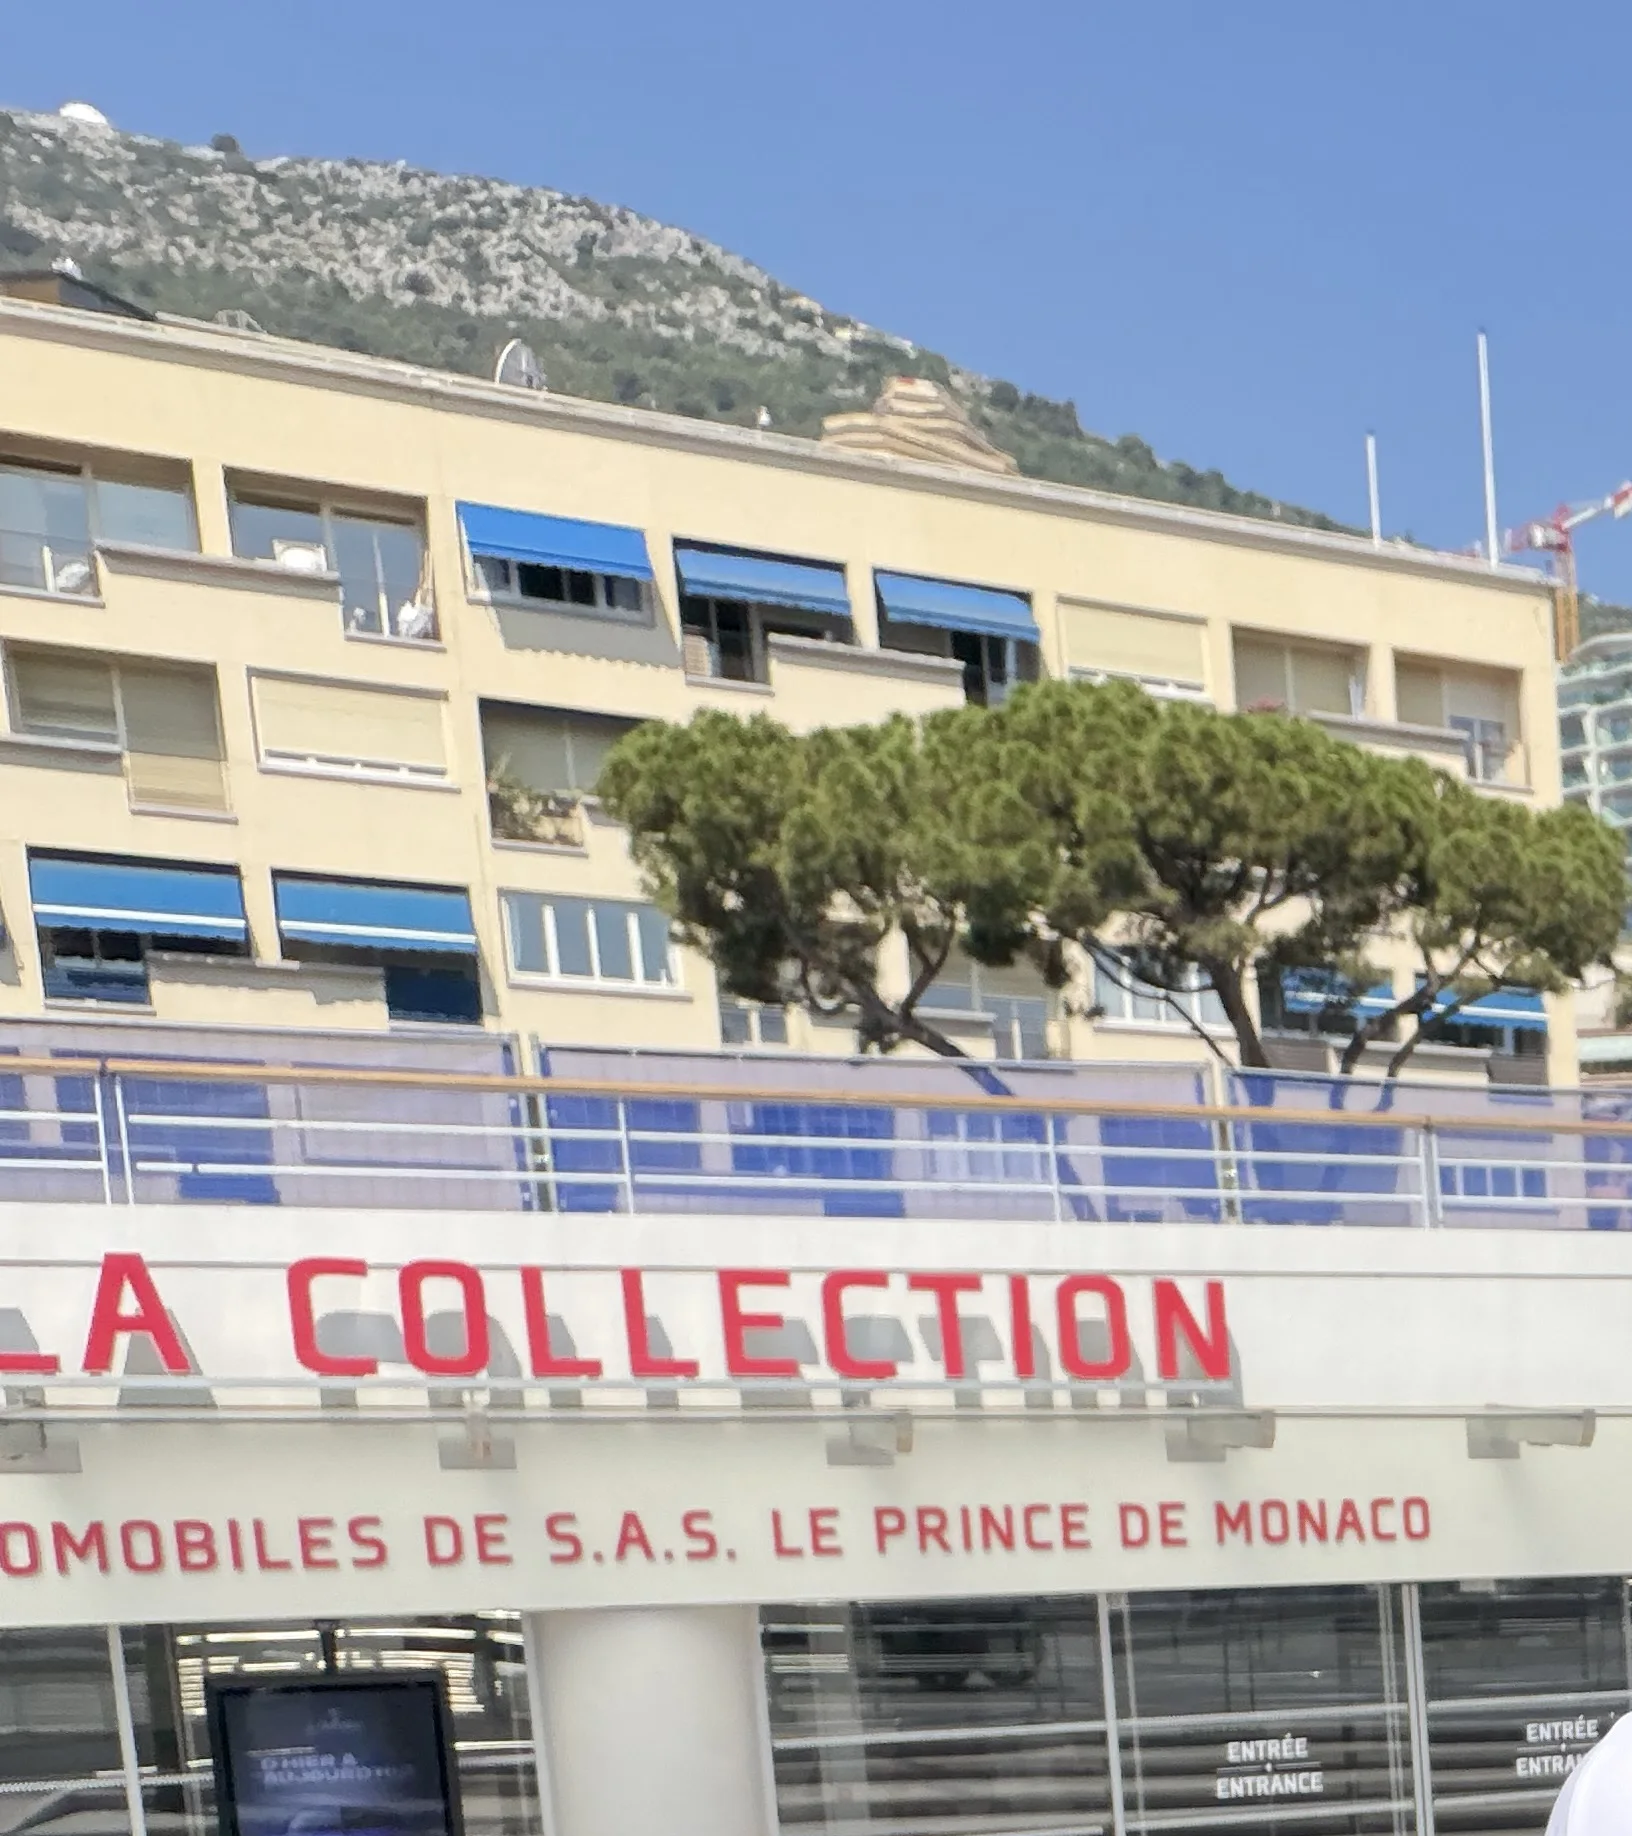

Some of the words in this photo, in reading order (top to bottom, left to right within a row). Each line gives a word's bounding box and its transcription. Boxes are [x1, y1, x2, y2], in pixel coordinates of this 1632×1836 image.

[287, 1256, 1231, 1380] COLLECTION
[0, 1516, 389, 1577] OMOBILES
[422, 1513, 512, 1567] DE
[545, 1510, 738, 1564] S.A.S.
[771, 1507, 842, 1558] LE
[873, 1502, 1091, 1554] PRINCE
[1118, 1500, 1188, 1550] DE
[1214, 1495, 1432, 1545] MONACO
[1526, 1714, 1599, 1743] ENTRÉE
[1227, 1732, 1309, 1763] ENTRÉE
[1216, 1771, 1324, 1800] ENTRANCE
